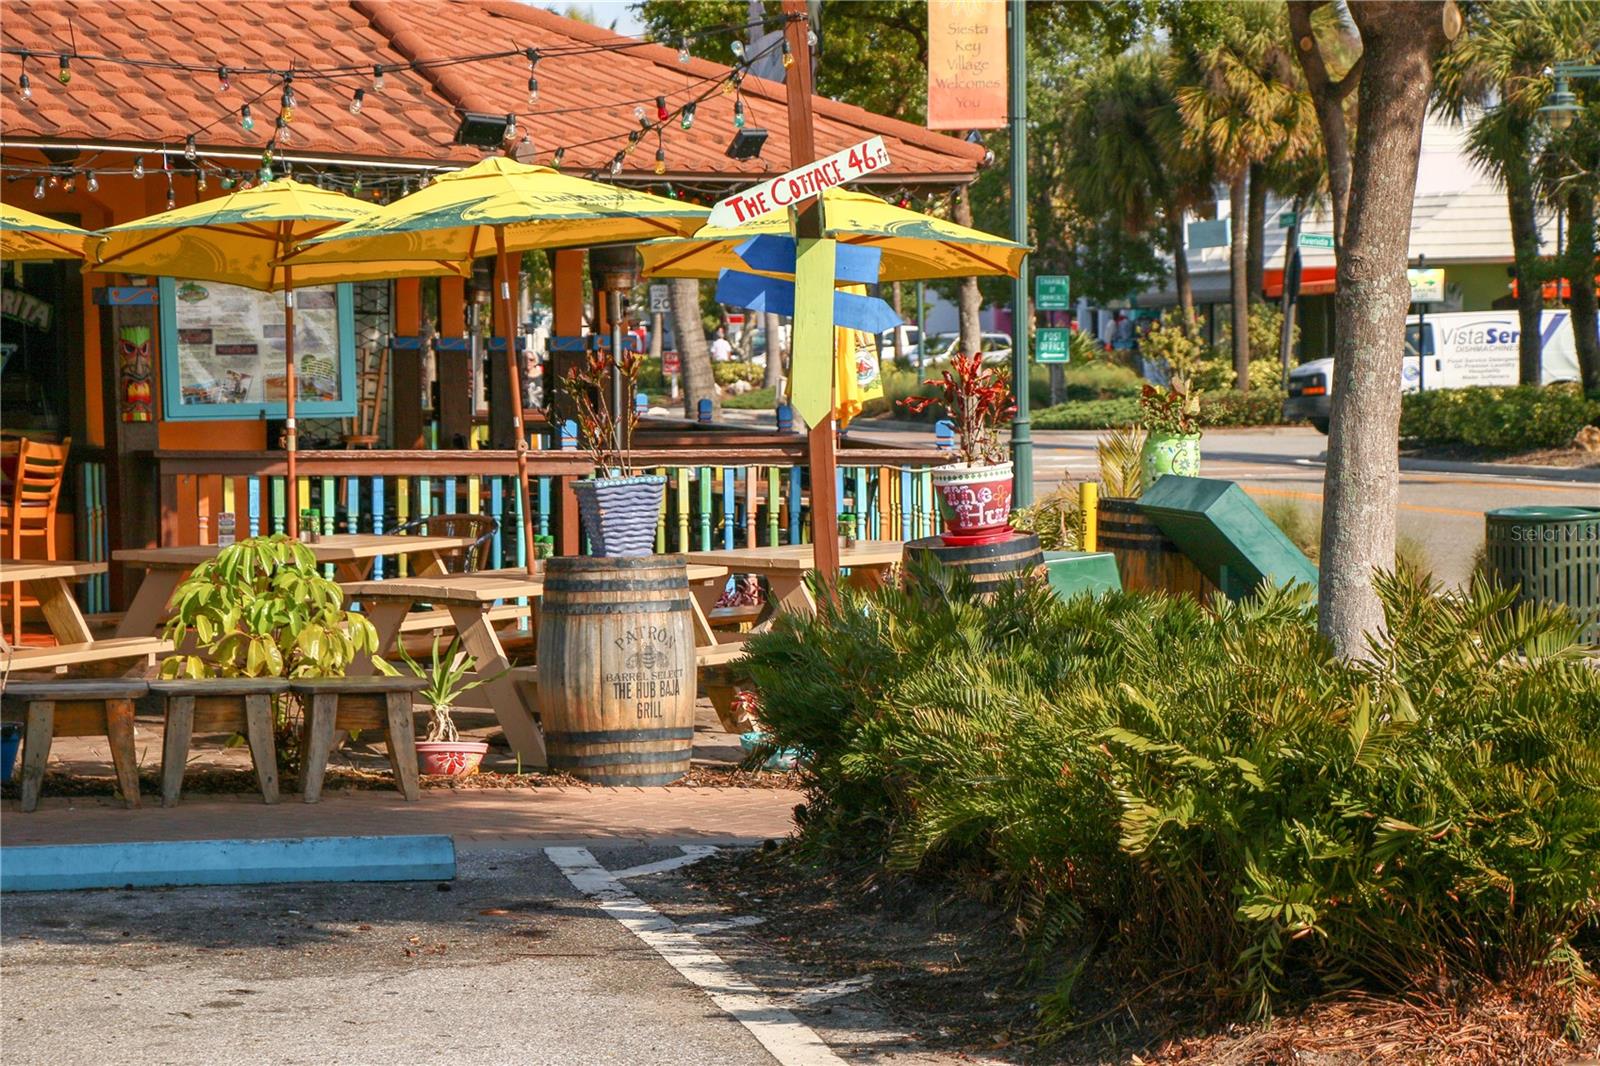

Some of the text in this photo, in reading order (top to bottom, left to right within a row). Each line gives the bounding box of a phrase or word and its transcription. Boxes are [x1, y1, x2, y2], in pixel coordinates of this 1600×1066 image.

[947, 23, 988, 35] Siesta
[955, 40, 981, 57] Key
[947, 55, 990, 76] Village
[935, 74, 1001, 89] Welcomes
[956, 97, 980, 108] You
[848, 143, 877, 173] 46
[653, 299, 671, 309] 20
[1043, 332, 1062, 341] POST
[1040, 342, 1066, 351] OFFICE
[606, 669, 683, 682] BARREL SELECT
[613, 679, 680, 700] THE HUB BAJA
[637, 701, 663, 719] GRILL
